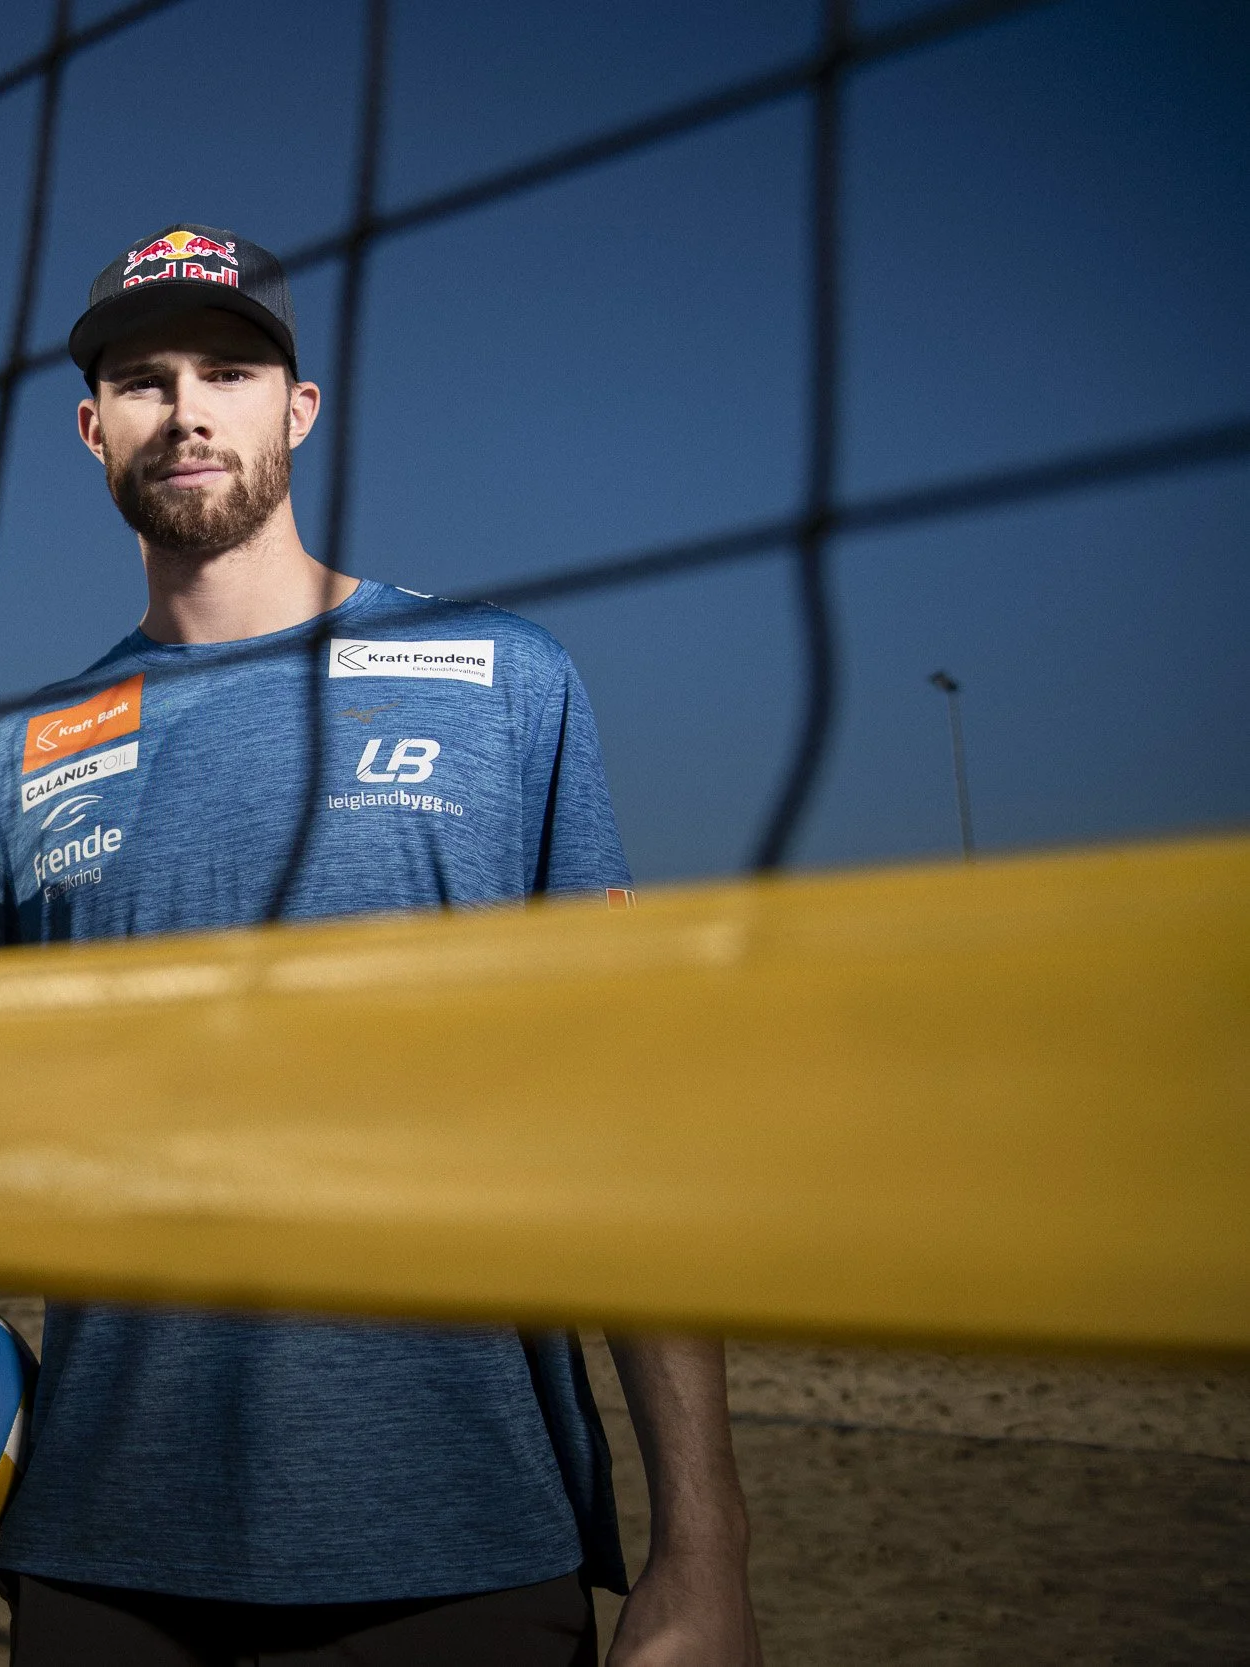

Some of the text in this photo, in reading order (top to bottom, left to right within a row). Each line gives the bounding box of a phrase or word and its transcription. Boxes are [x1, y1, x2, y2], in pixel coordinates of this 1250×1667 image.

[368, 653, 486, 667] Kraft Fondene
[58, 701, 129, 737] Kraft Bank
[26, 751, 132, 802] CALANUS OIL
[356, 738, 441, 783] LB
[328, 790, 464, 817] leiglandbygg.no
